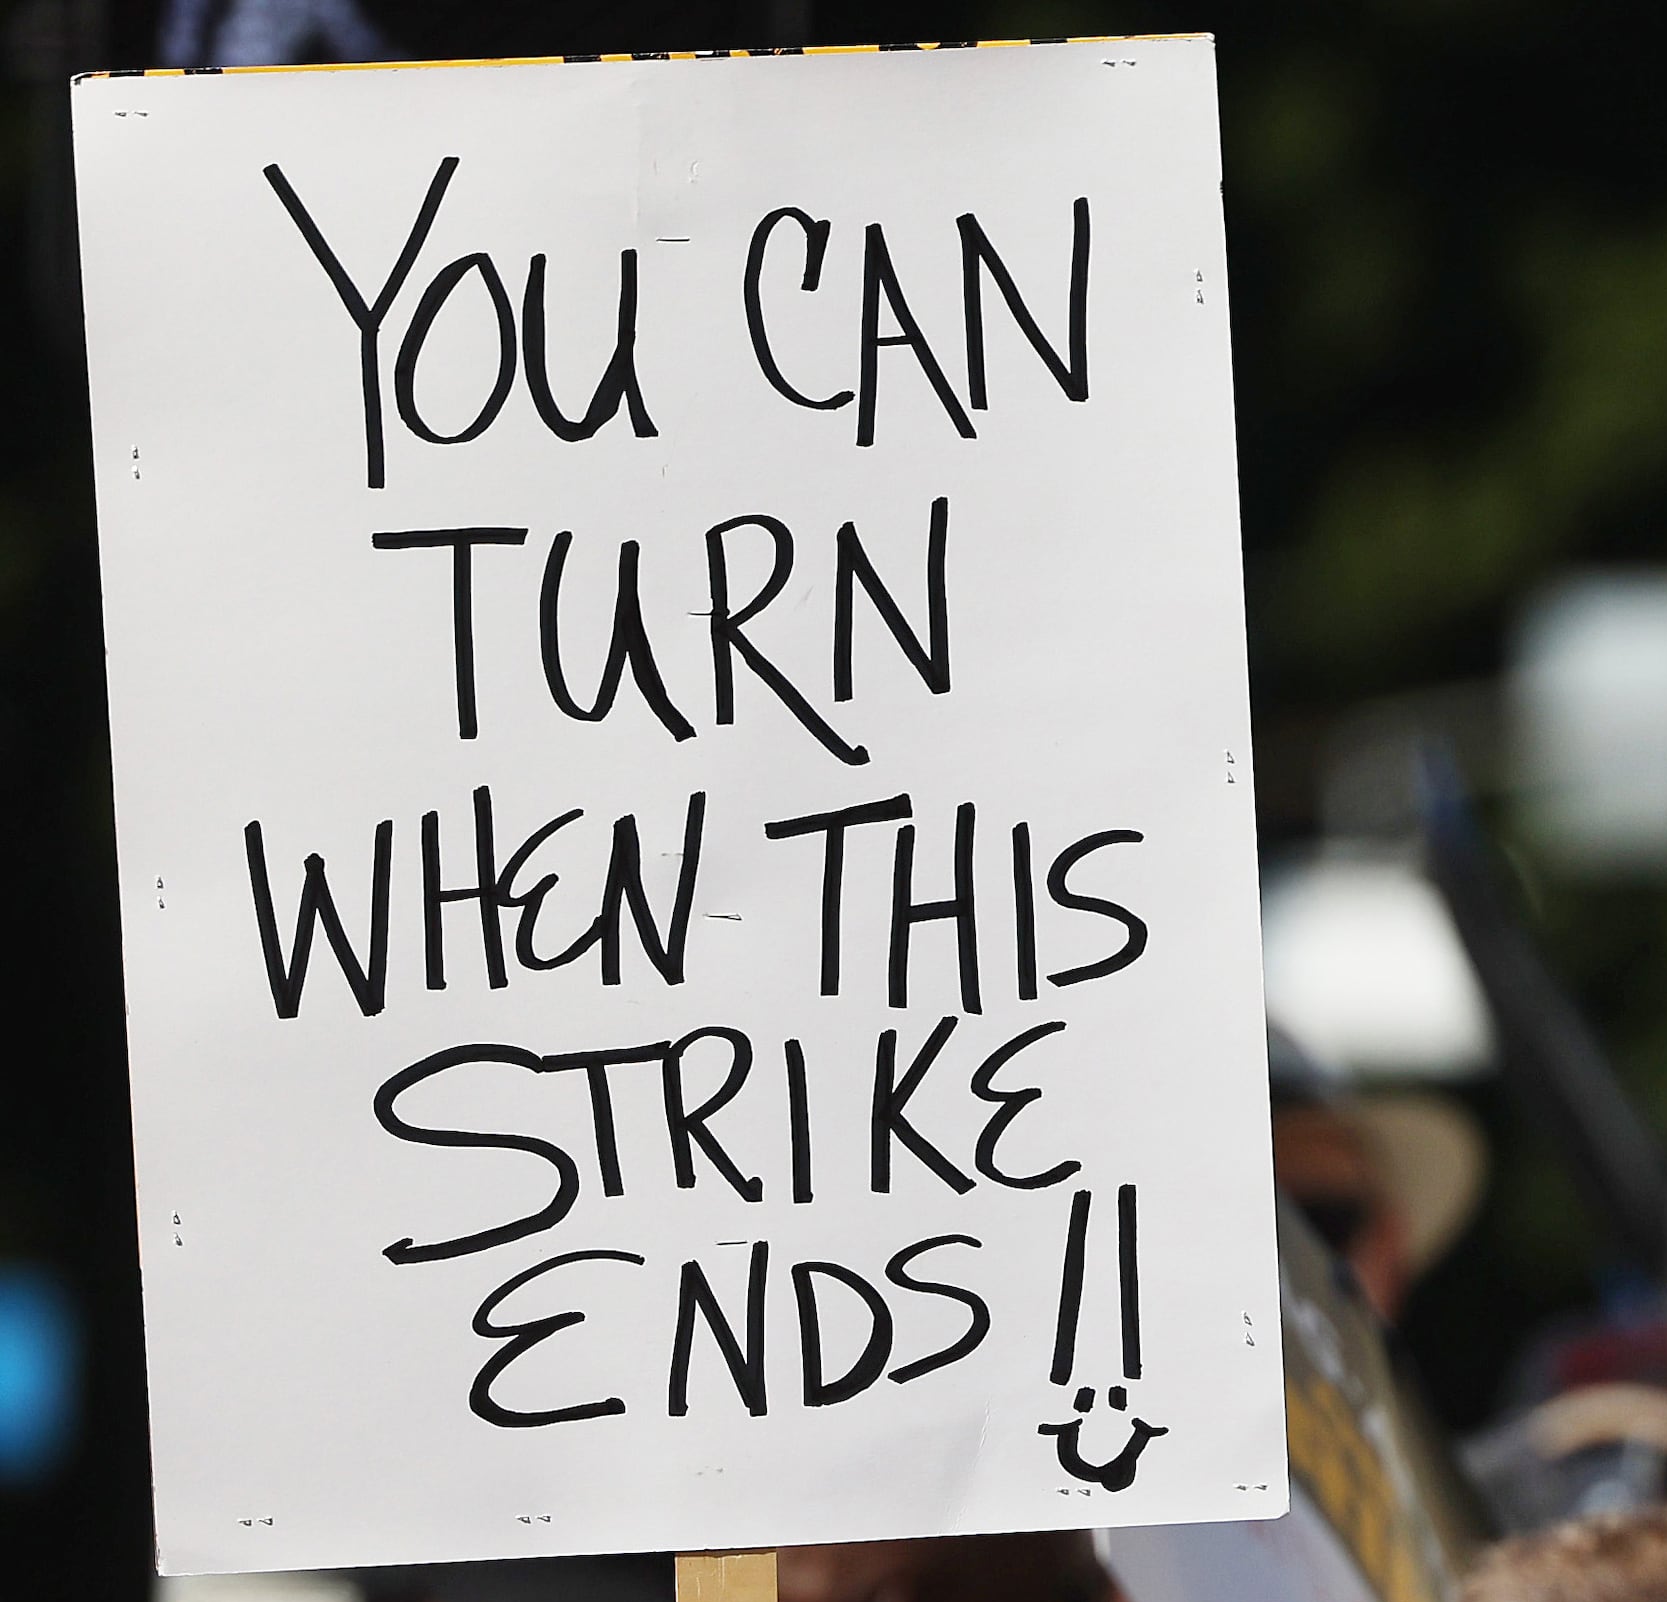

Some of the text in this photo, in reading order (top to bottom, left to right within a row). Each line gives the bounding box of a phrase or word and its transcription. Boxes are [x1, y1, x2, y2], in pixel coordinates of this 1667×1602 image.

[263, 157, 1090, 488] YOU CAN
[372, 497, 950, 765] TURN
[245, 786, 1147, 1019] WHEN THIS
[374, 1016, 1081, 1265] STRIKE
